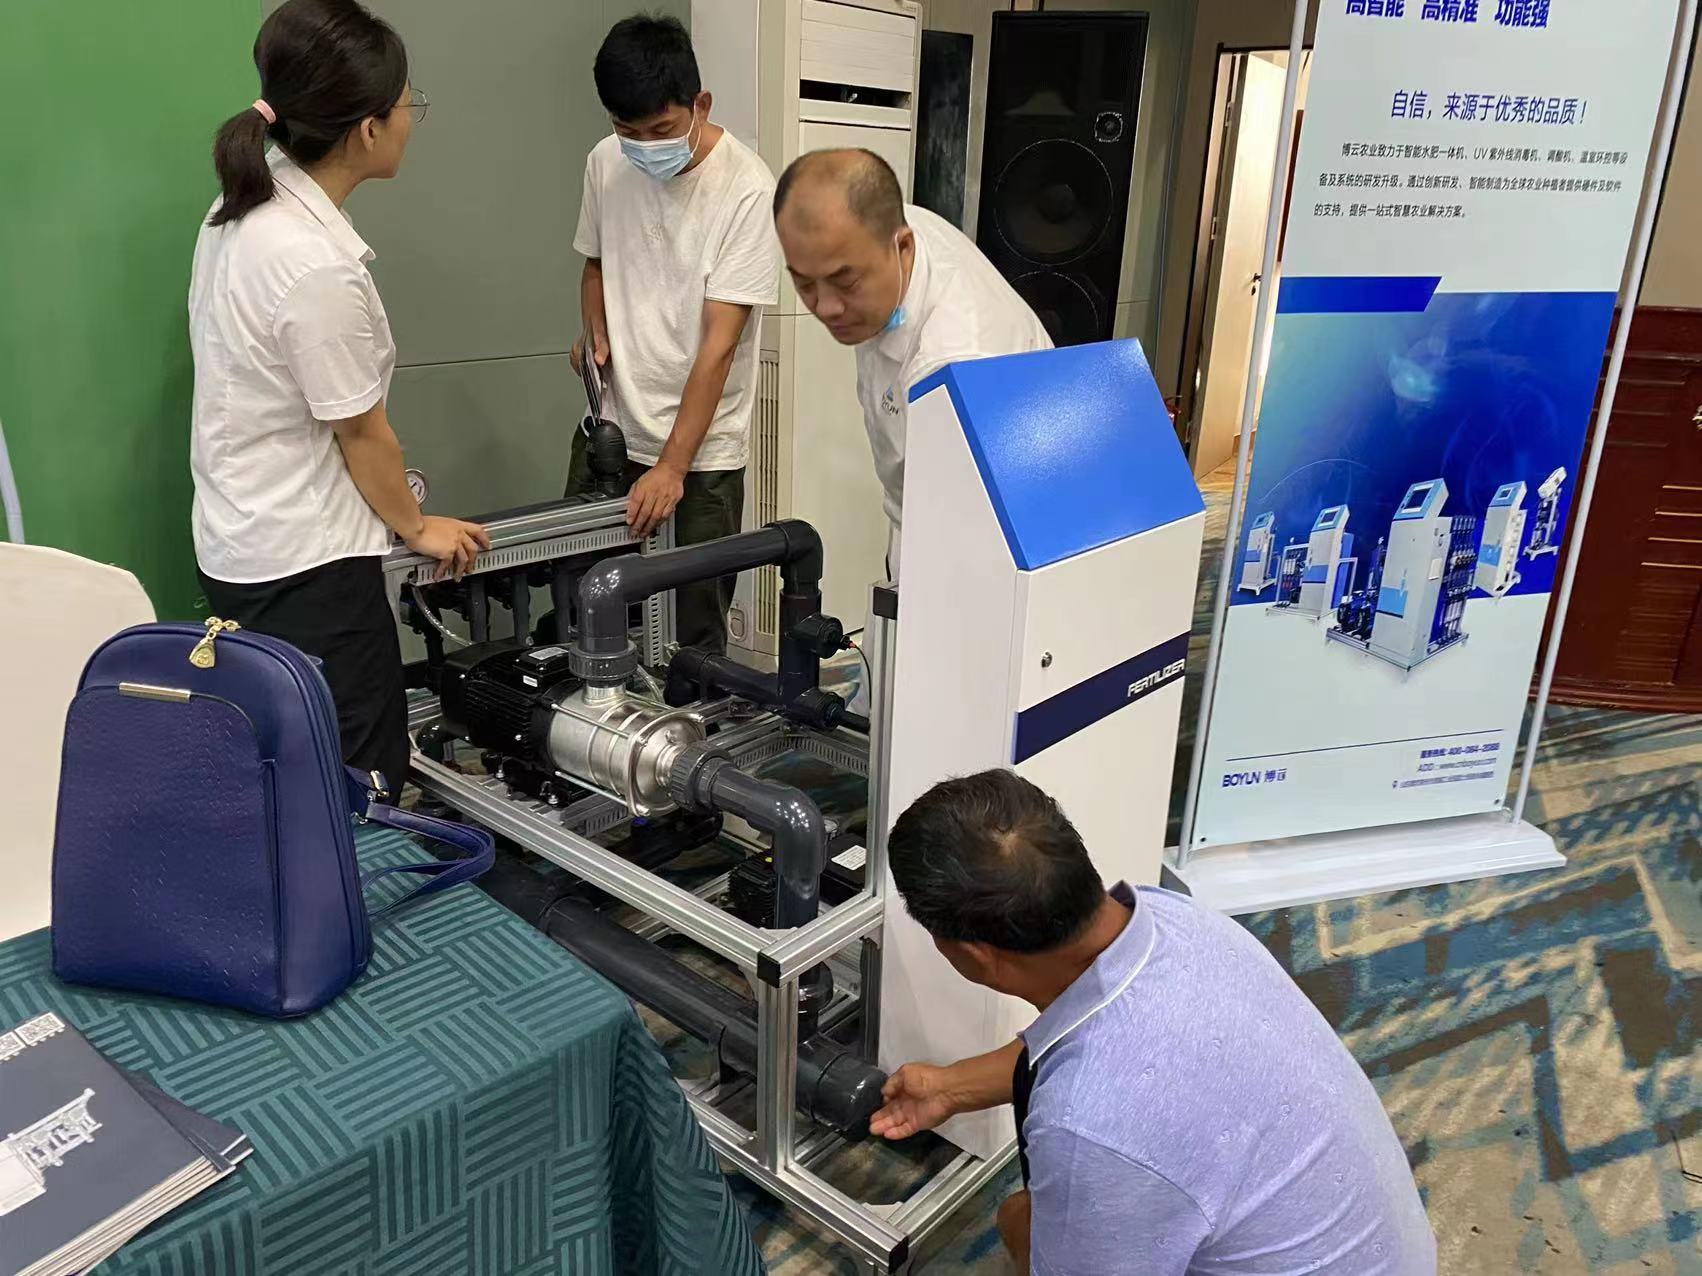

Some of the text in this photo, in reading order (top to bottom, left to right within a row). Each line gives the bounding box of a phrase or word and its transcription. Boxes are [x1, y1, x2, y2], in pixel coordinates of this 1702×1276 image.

[1494, 0, 1550, 28] 功能强
[1391, 89, 1586, 125] 自信，来源于优秀的品质！
[1127, 658, 1185, 697] FERTILIZER
[1222, 771, 1261, 787] BOYUN
